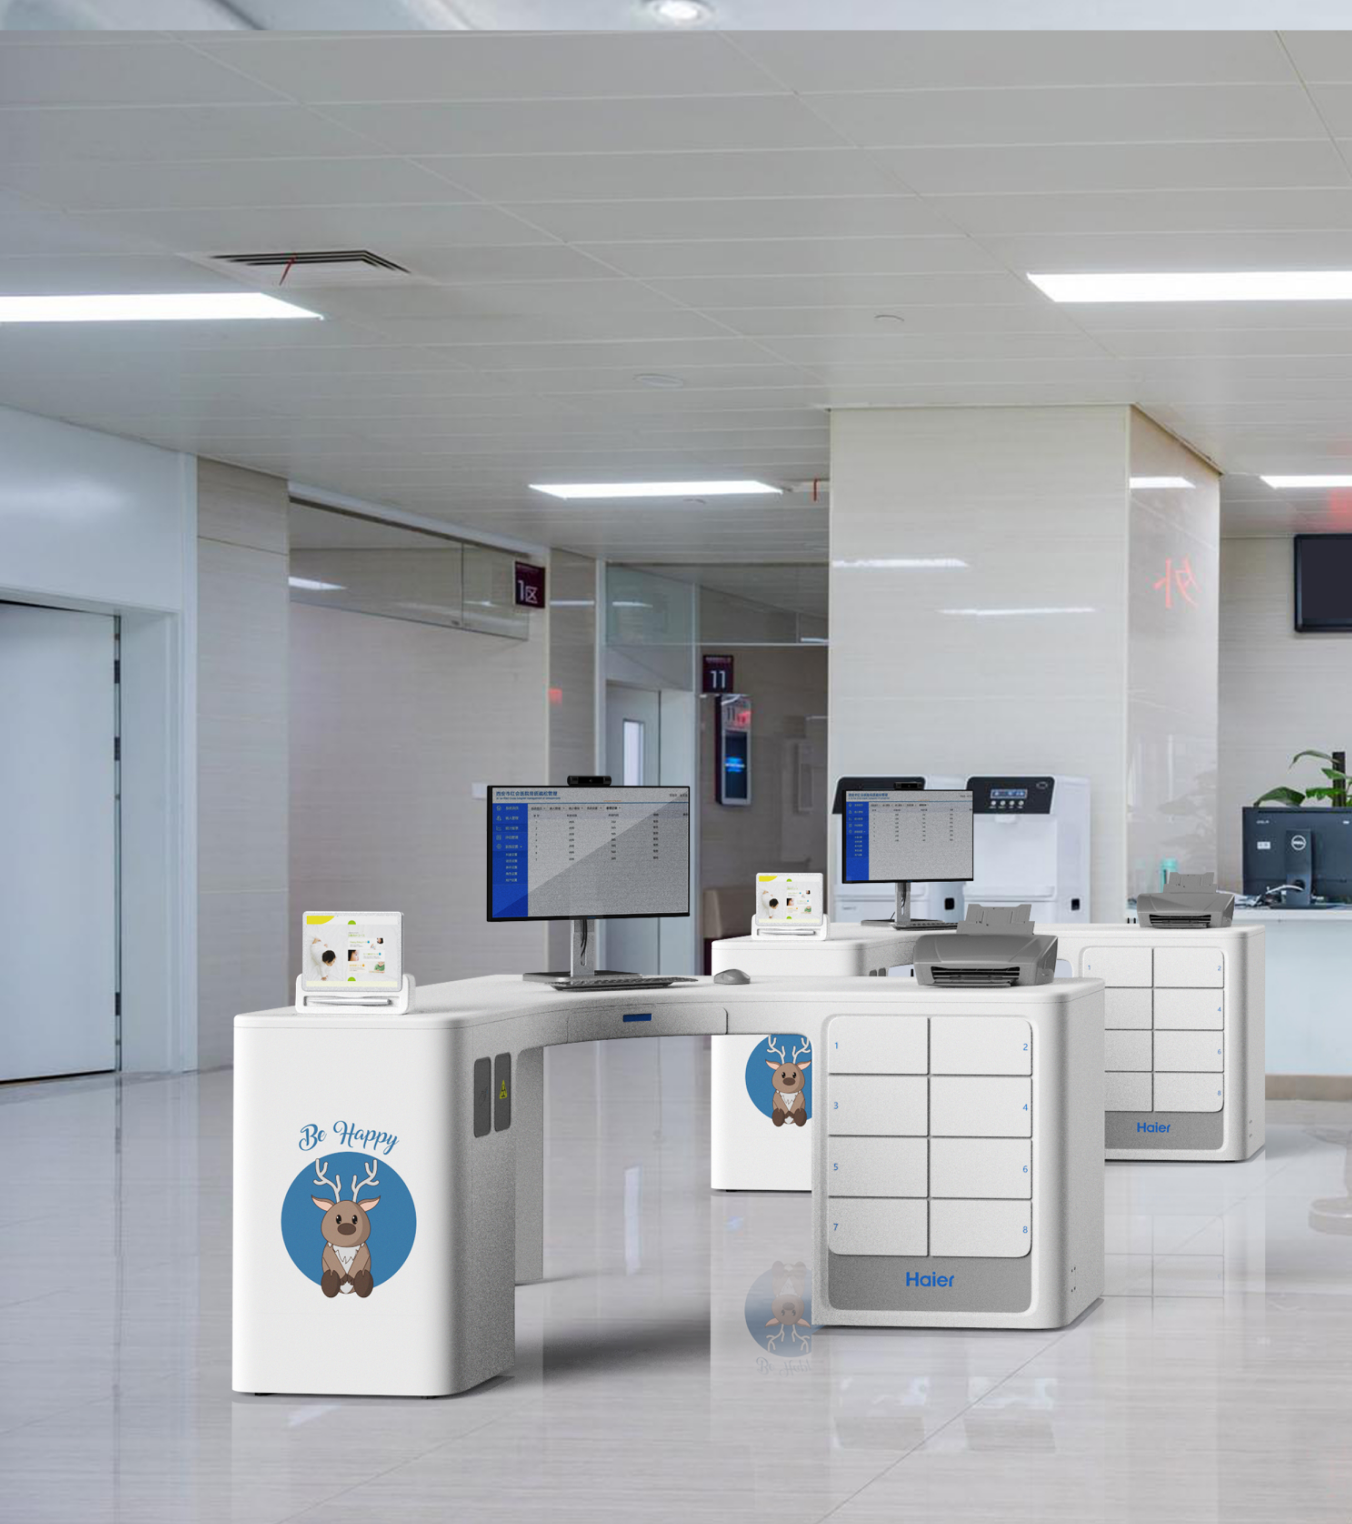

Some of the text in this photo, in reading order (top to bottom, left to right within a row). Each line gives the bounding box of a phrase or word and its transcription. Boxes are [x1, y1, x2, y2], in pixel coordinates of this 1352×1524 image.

[517, 579, 538, 604] 1区
[710, 670, 726, 689] 11
[1136, 1121, 1171, 1134] Haier
[298, 1120, 400, 1155] Be Happy
[905, 1271, 955, 1288] Haier
